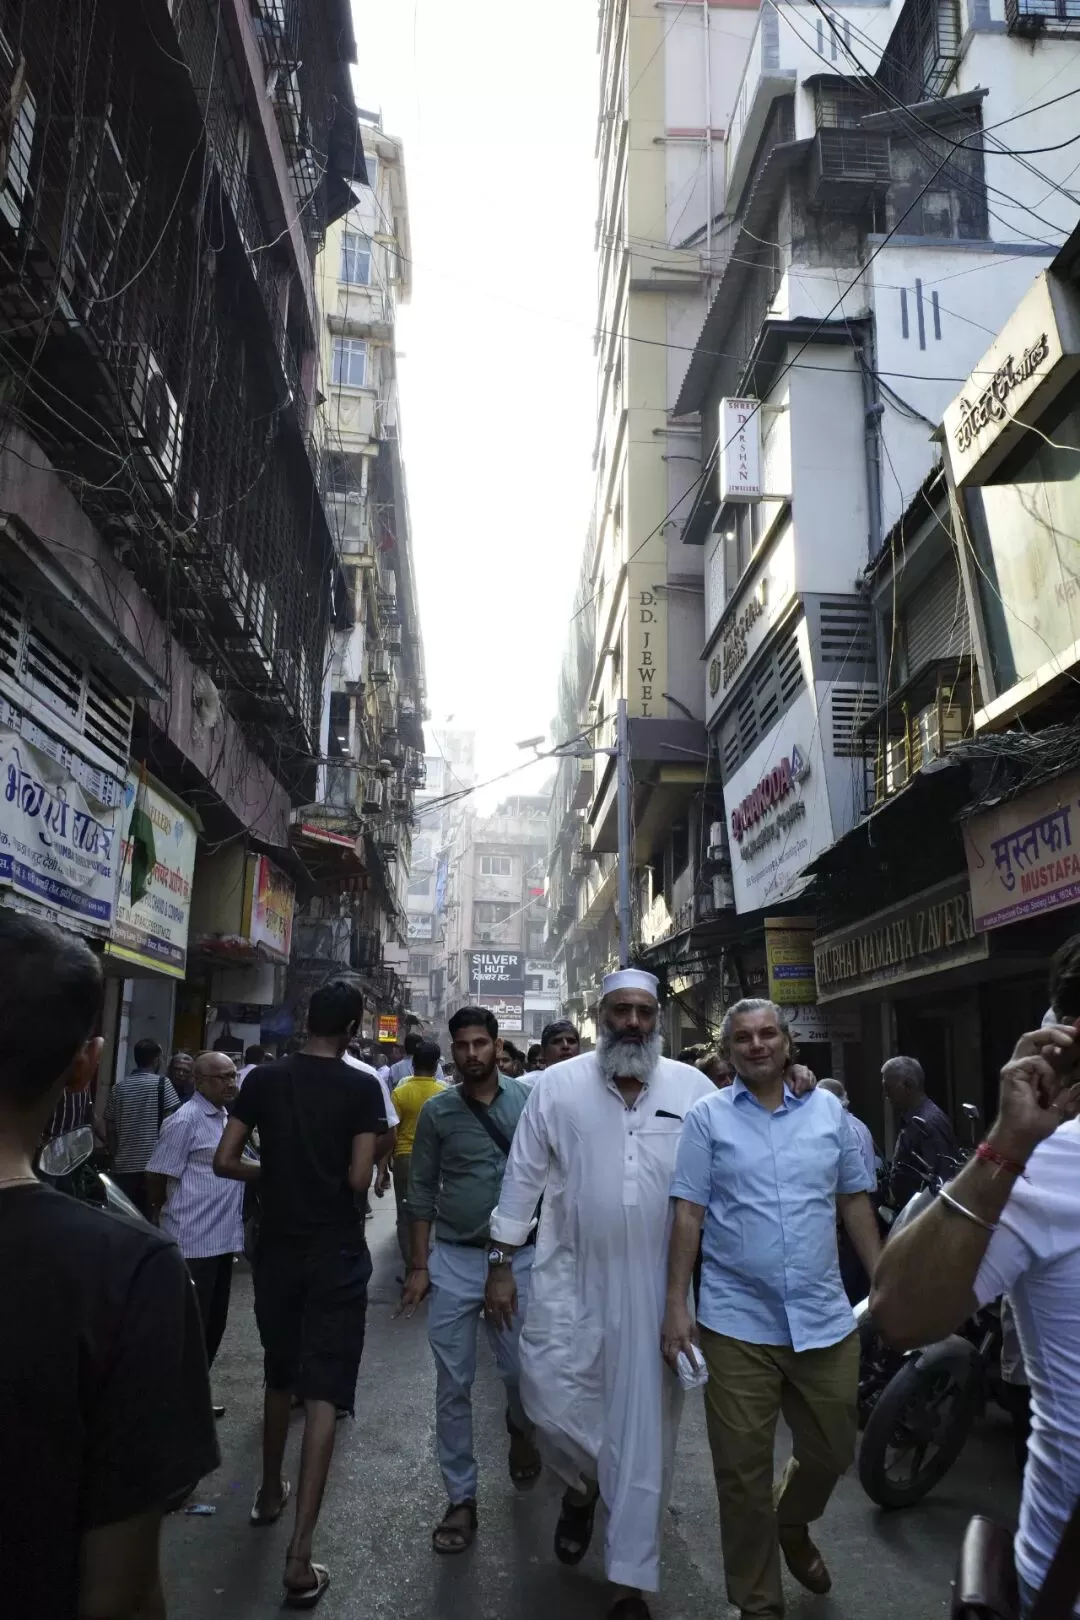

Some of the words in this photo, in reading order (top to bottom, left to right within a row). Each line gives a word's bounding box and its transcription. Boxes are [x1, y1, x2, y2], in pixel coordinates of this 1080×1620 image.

[728, 402, 755, 410] SHREE
[737, 414, 749, 480] DARSHAN
[638, 632, 657, 718] JEWEL
[990, 803, 1071, 891] मुस्तफा
[1021, 852, 1080, 894] MUSTAFA
[472, 954, 518, 965] SILVER
[484, 965, 506, 973] HUT
[808, 1029, 830, 1039] 2nd
